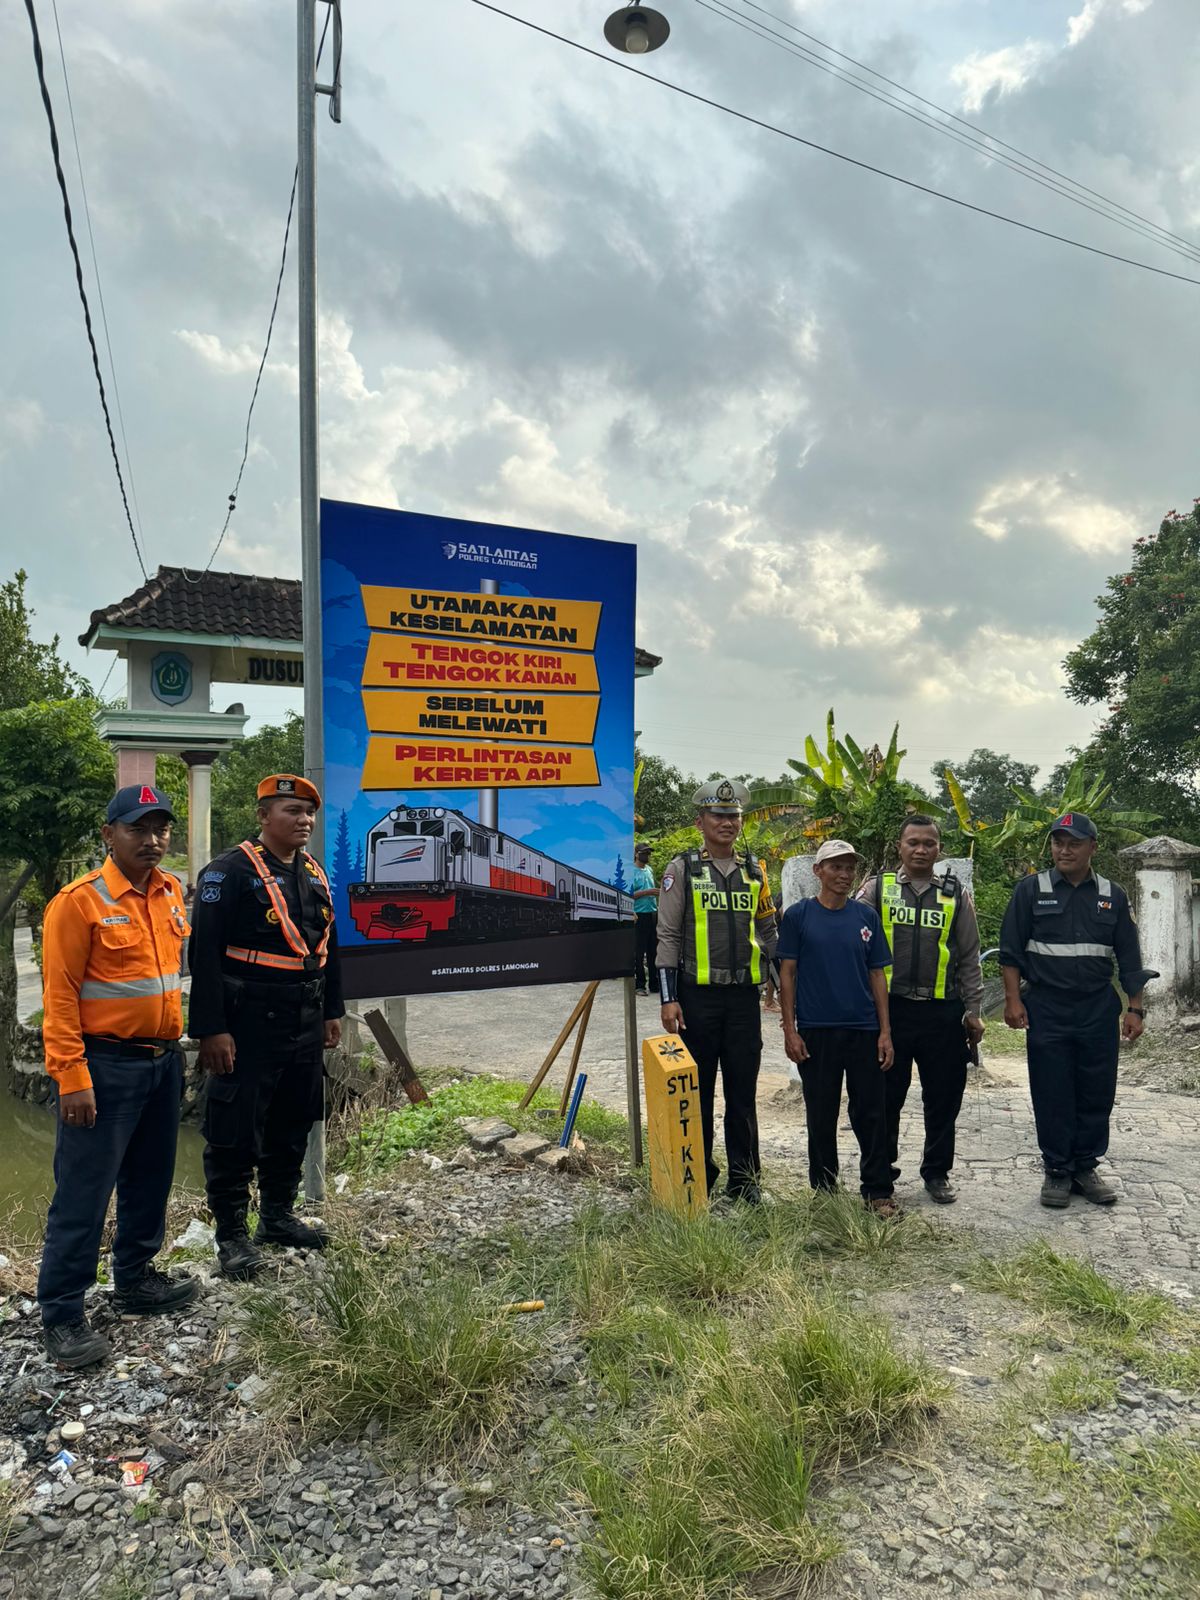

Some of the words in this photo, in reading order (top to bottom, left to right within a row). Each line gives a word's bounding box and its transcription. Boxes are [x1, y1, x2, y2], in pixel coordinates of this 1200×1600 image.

[458, 542, 538, 563] SATLANTAS
[458, 553, 490, 563] POLRES
[492, 557, 537, 570] LAMONGAN
[410, 593, 556, 621] UTAMAKAN
[390, 611, 577, 643] KESELAMATAN
[411, 643, 520, 666] TENGOK
[523, 653, 562, 670] KIRI
[383, 661, 502, 683] TENGOK
[505, 668, 577, 685] KANAN
[426, 695, 544, 715] SEBELUM
[419, 713, 547, 735] MELEWATI
[395, 744, 571, 764] PERLINTASAN
[413, 766, 521, 782] KERETA
[525, 767, 561, 781] API
[139, 785, 159, 803] A
[1060, 813, 1074, 827] A
[475, 965, 500, 973] POLRES
[502, 962, 539, 971] LAMONGAN
[667, 1072, 698, 1095] STL
